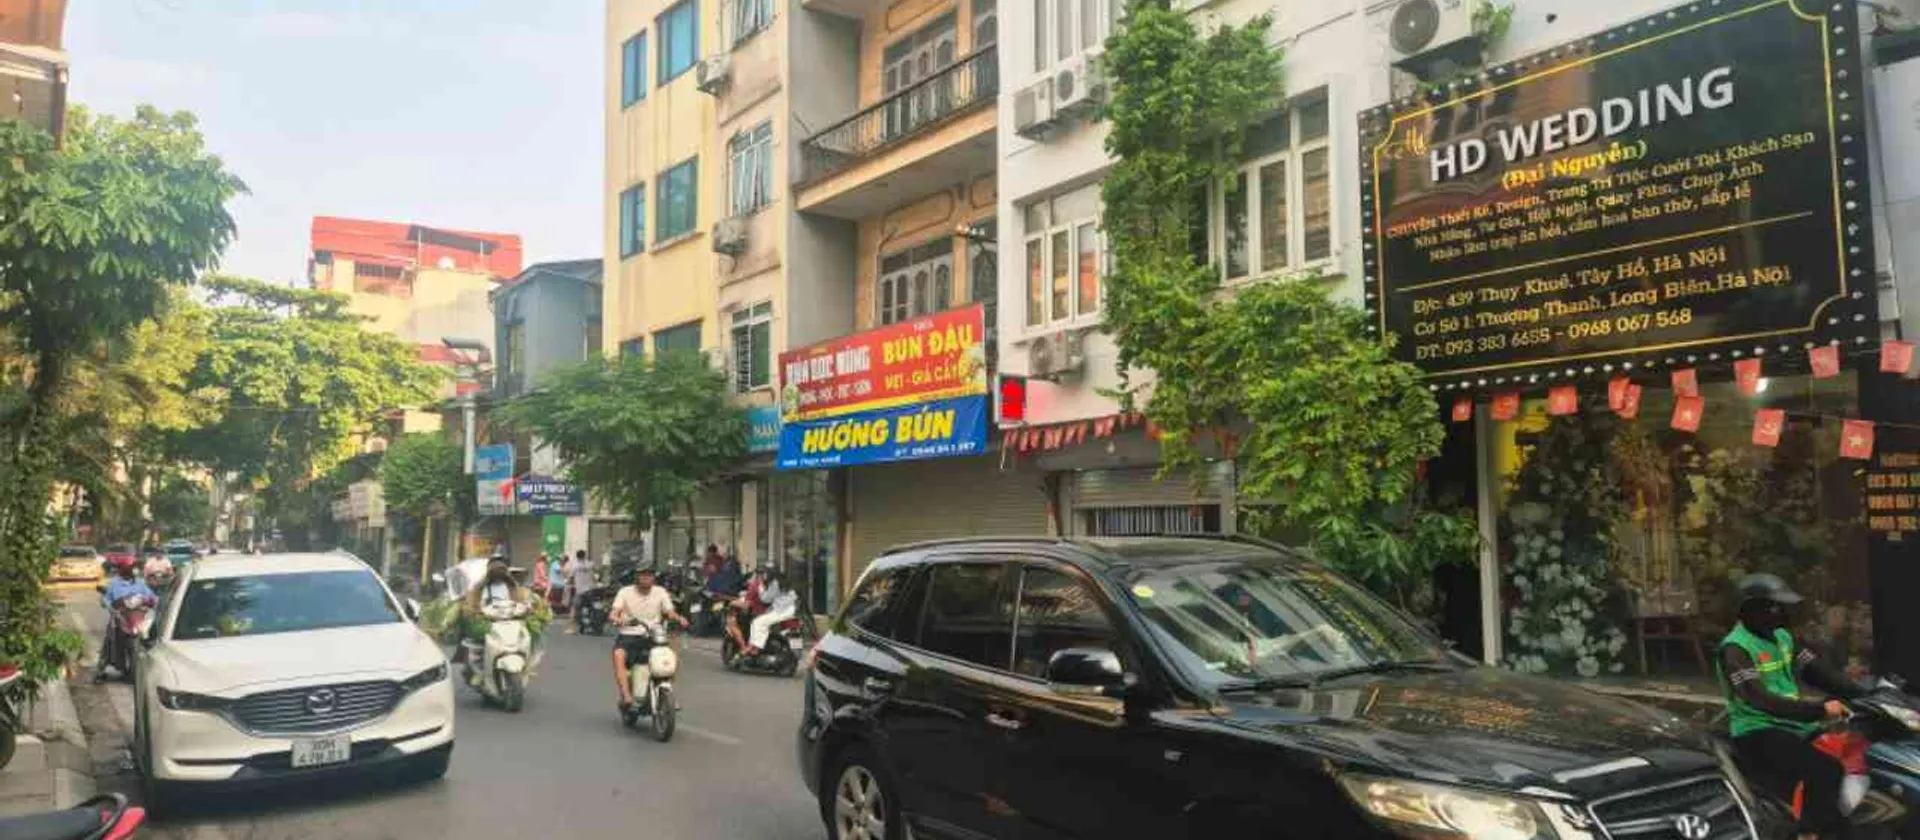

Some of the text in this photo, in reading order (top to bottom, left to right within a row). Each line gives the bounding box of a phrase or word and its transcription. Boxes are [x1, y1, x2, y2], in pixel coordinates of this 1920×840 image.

[1430, 138, 1487, 182] HD
[1499, 65, 1734, 162] WEDDING
[1548, 180, 1588, 203] Trang
[1726, 138, 1778, 162] Khách
[1781, 129, 1817, 150] Sạn
[1576, 266, 1612, 286] Tây
[1653, 253, 1682, 274] Hà
[1689, 245, 1727, 268] Nội
[1609, 287, 1658, 308] Long
[1751, 264, 1792, 286] Nội
[883, 320, 973, 366] BÚN ĐẬU
[1444, 339, 1473, 356] 093
[1567, 316, 1611, 339] 0968
[1615, 312, 1651, 332] 067
[1656, 307, 1693, 328] 568
[895, 405, 956, 443] BÚN
